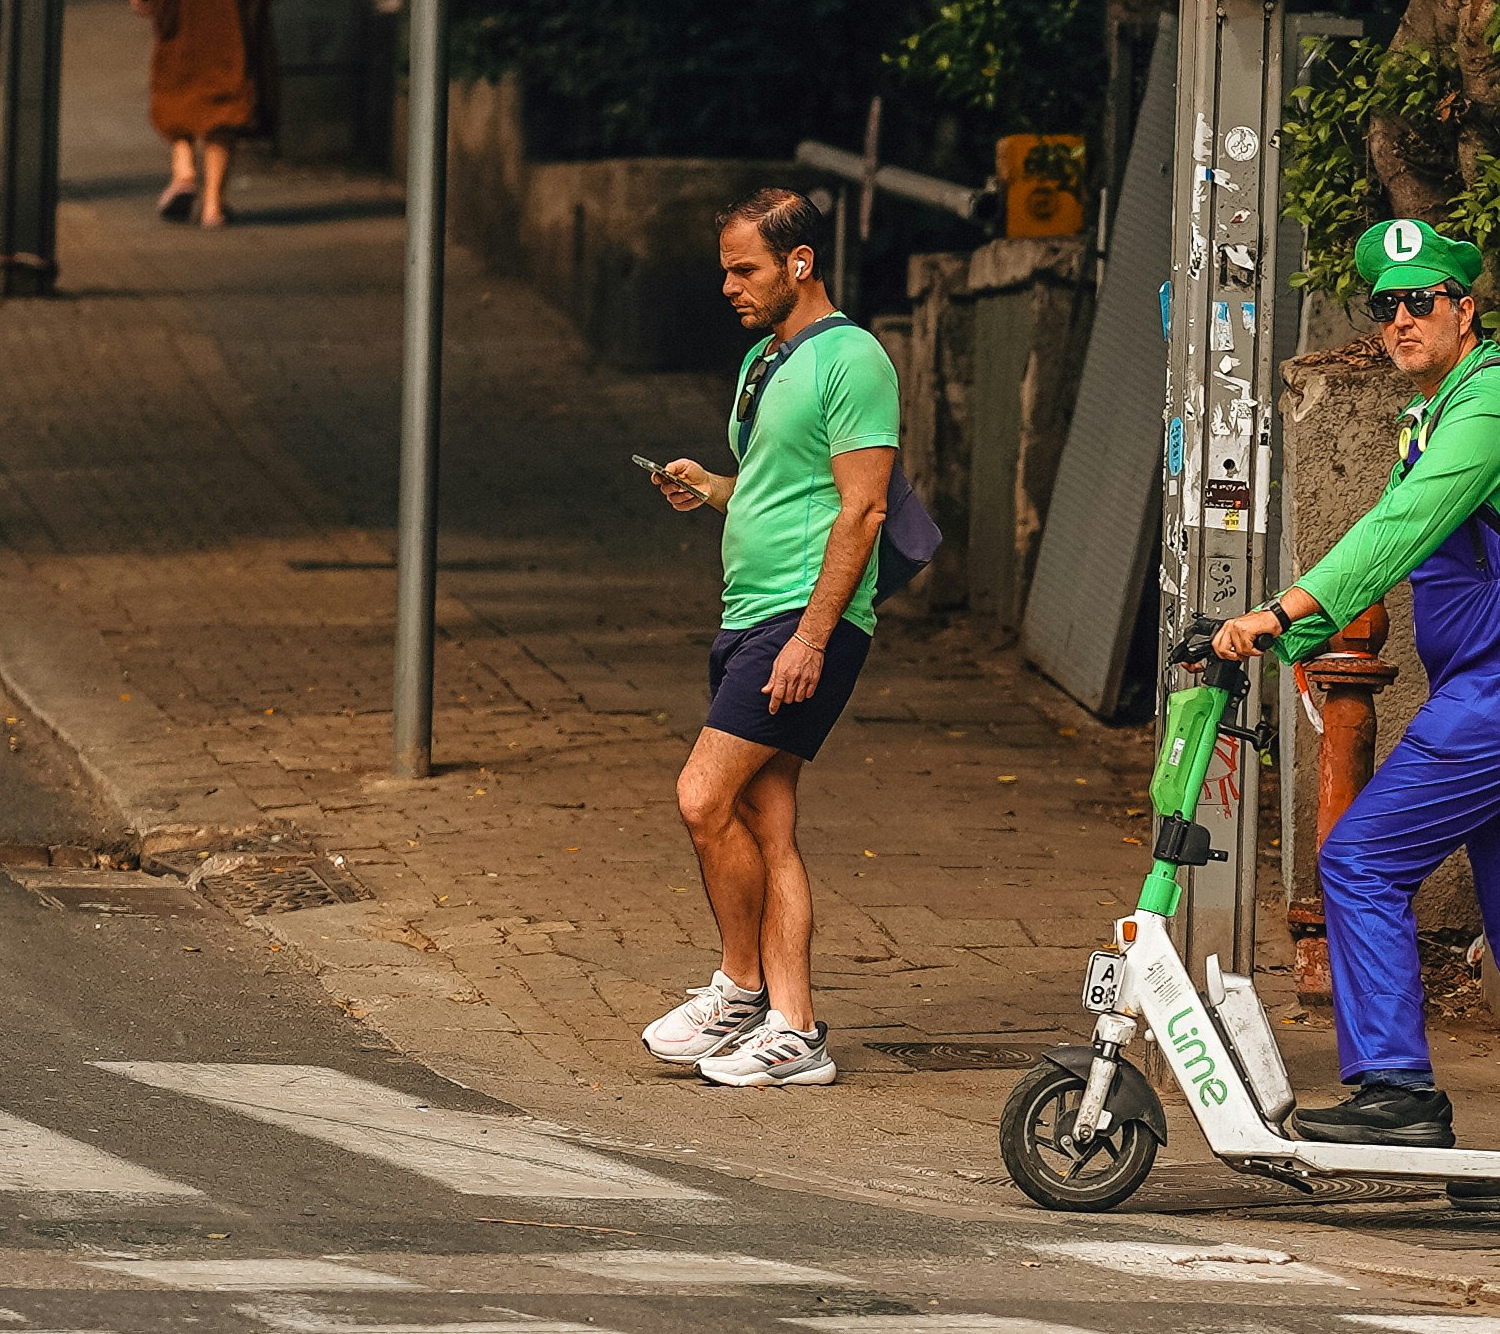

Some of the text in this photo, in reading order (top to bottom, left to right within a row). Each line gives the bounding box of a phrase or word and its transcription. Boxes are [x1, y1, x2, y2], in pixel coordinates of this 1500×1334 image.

[1396, 228, 1412, 253] L
[1101, 963, 1115, 983] A
[1167, 1006, 1228, 1108] Lime
